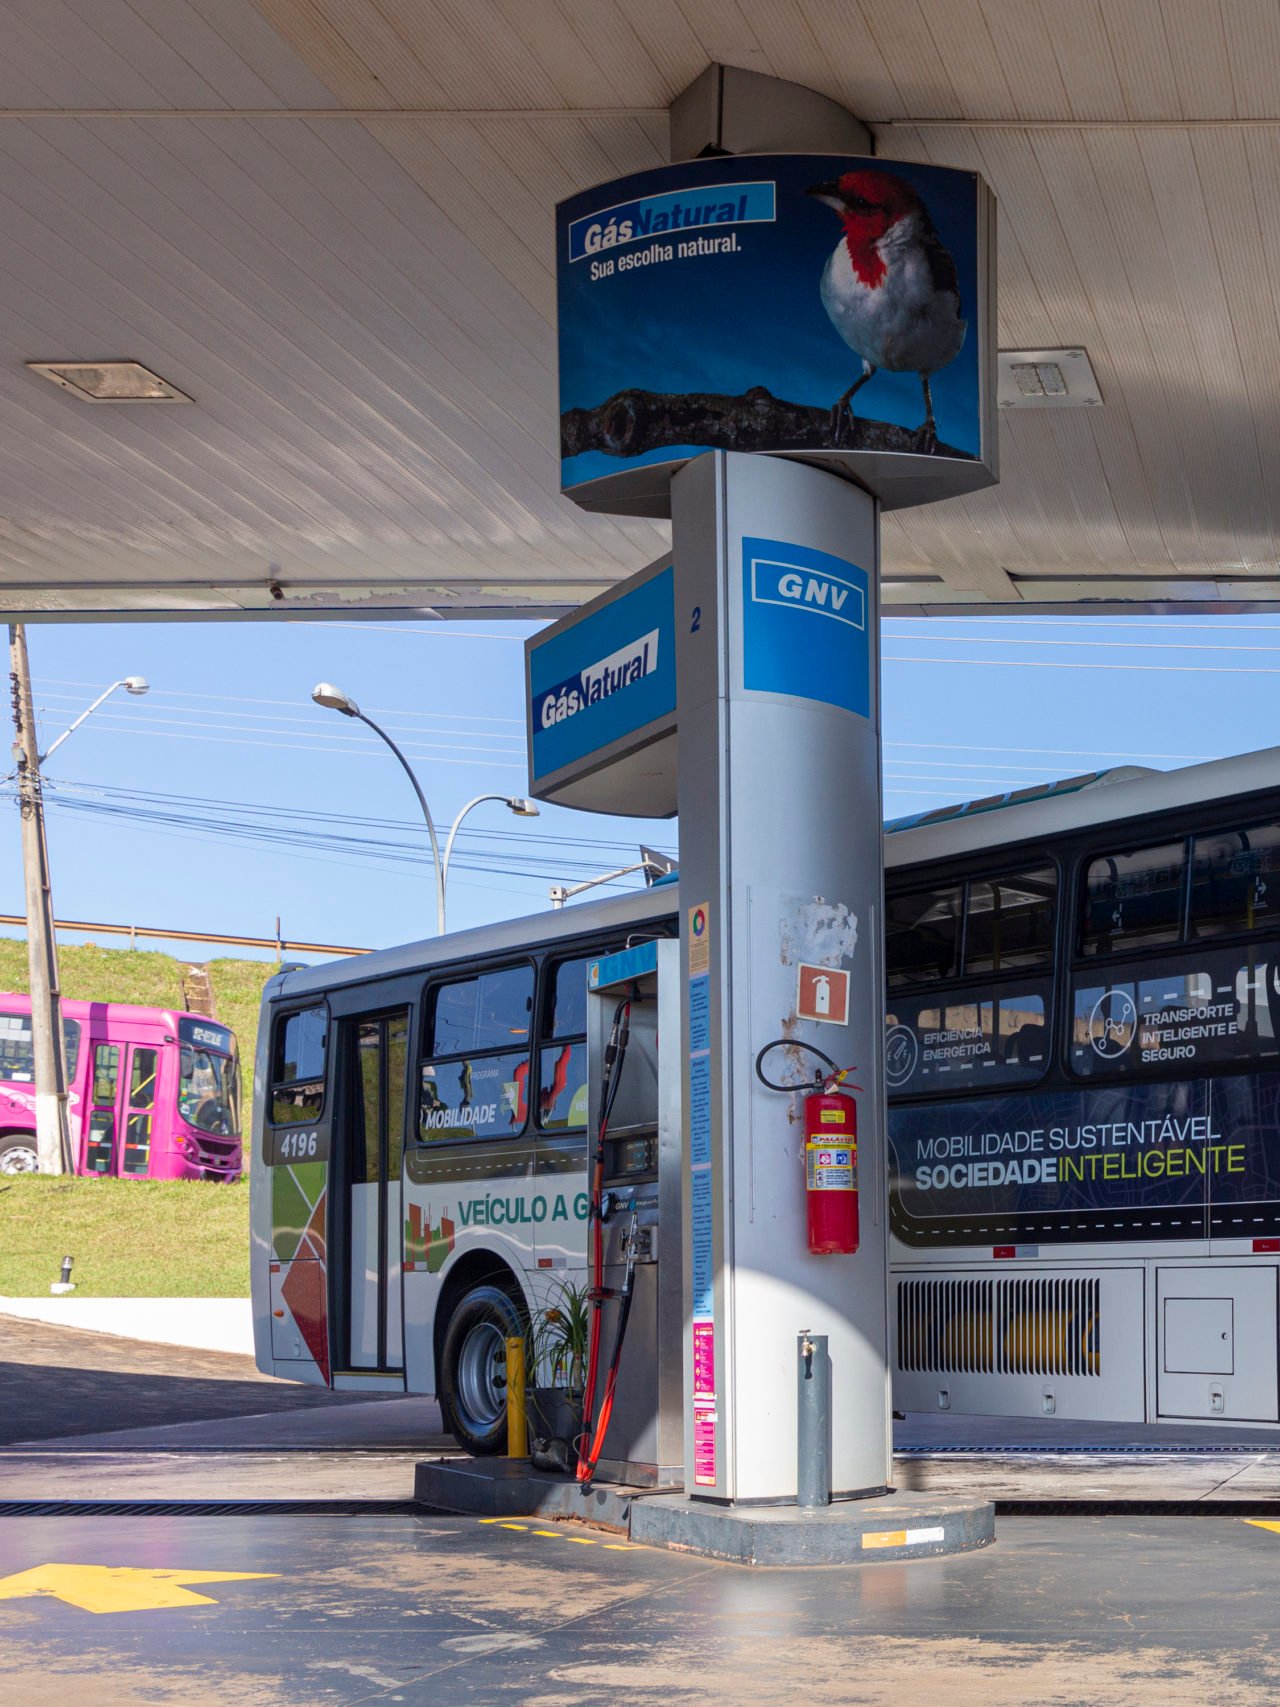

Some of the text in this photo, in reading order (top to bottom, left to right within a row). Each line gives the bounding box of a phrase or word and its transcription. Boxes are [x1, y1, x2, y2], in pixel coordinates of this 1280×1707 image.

[591, 233, 742, 281] Sua escolha natural.
[778, 574, 849, 611] GNV
[690, 607, 701, 633] 2
[1143, 1003, 1234, 1025] TRANSPORTE
[924, 1026, 983, 1045] EFICIÊNCIA
[1142, 1021, 1238, 1044] INTELIGENTE E
[923, 1042, 991, 1061] ENERGÉTICA
[1141, 1045, 1196, 1063] SEGURO
[471, 1069, 499, 1080] PROGRAMA
[425, 1103, 497, 1130] MOBILIDADE
[281, 1132, 317, 1158] 4196
[916, 1113, 1221, 1161] MOBILIDADE SUSTENTÁVEL
[458, 1193, 548, 1226] VEÍCULO
[552, 1193, 568, 1222] A
